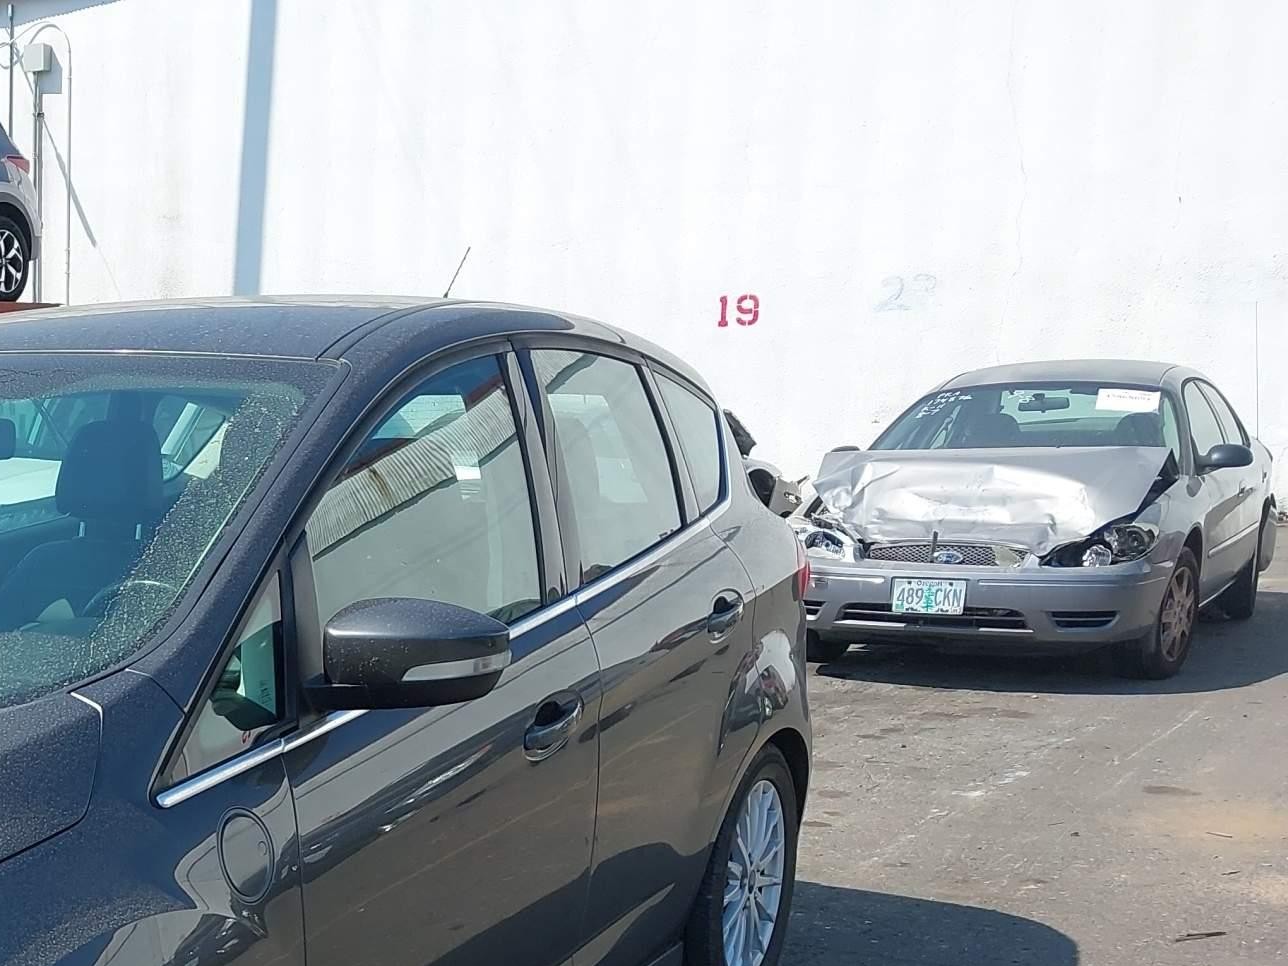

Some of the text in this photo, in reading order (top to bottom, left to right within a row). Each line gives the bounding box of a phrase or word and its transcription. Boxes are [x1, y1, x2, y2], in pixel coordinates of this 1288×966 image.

[718, 294, 760, 327] 19
[896, 587, 963, 607] 489 CKN
